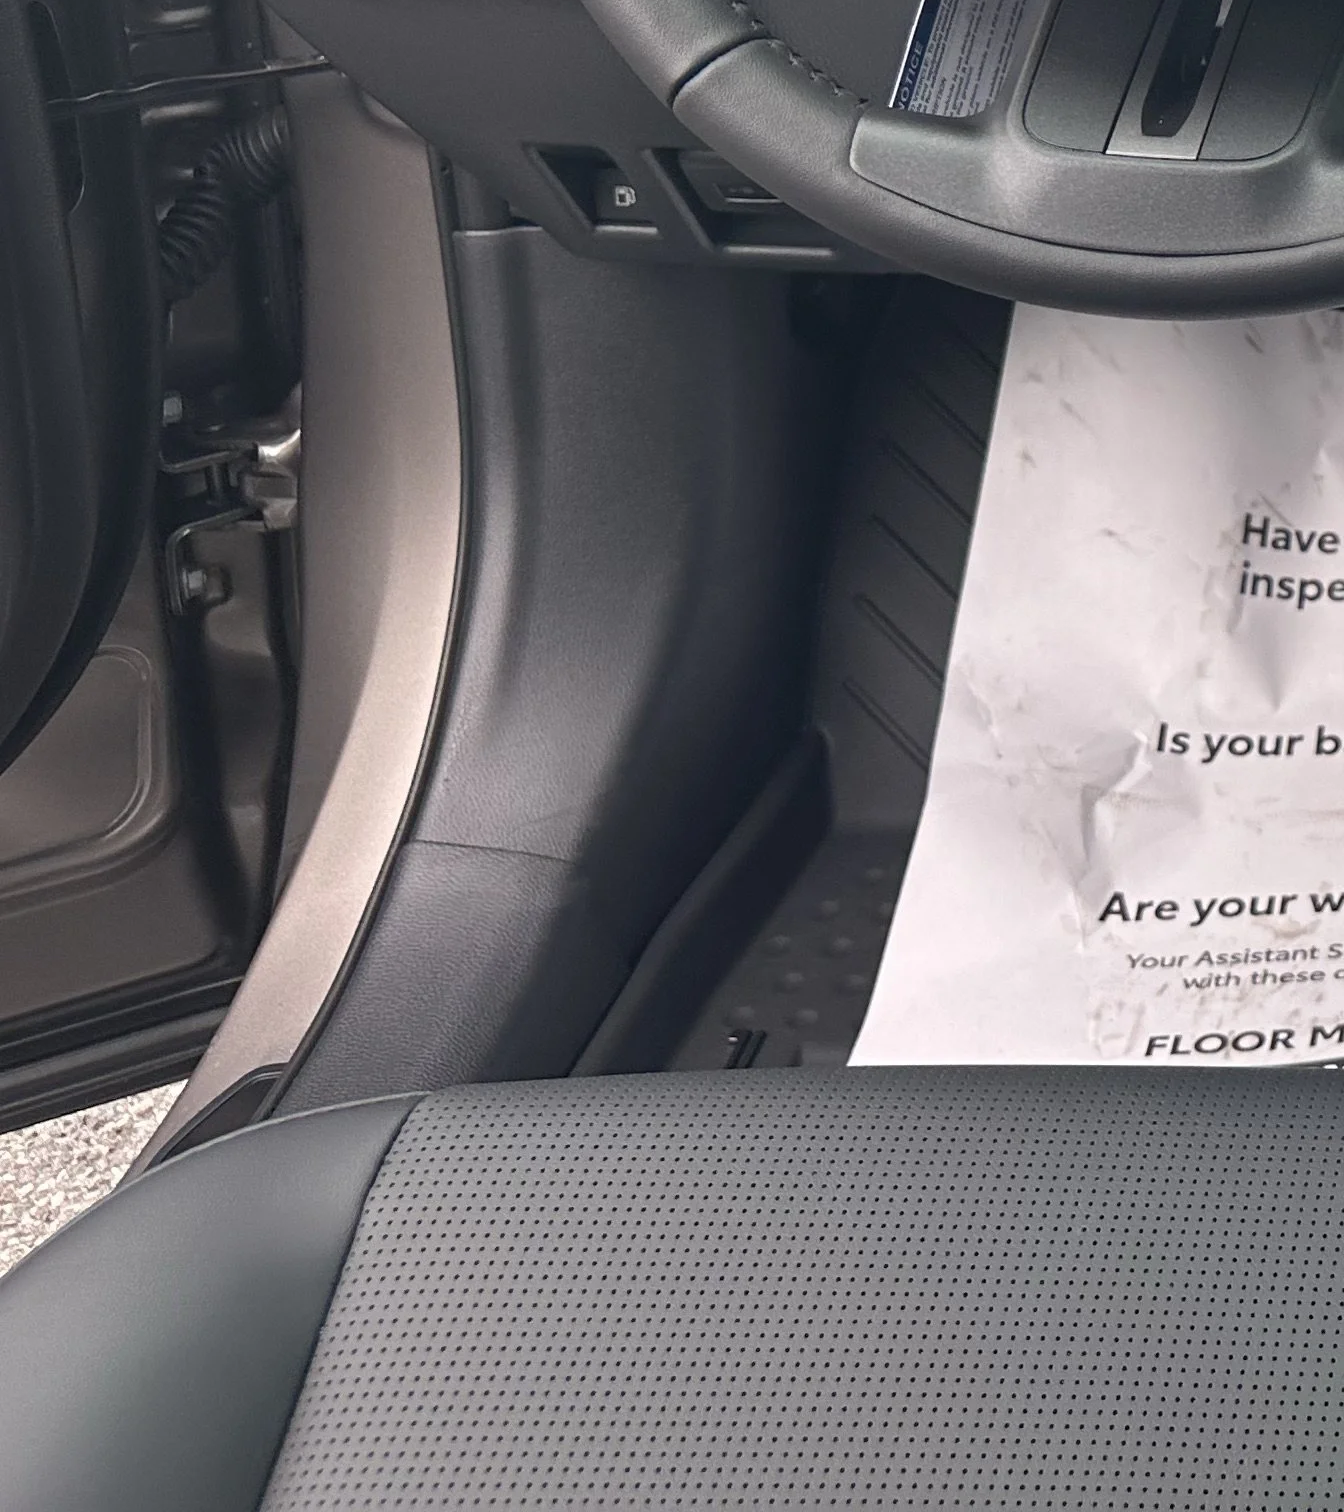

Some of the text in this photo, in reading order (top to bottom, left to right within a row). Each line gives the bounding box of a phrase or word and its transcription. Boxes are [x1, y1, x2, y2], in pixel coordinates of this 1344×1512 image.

[1242, 512, 1340, 554] Have
[1155, 722, 1190, 755] Is
[1203, 730, 1304, 763] your
[1099, 890, 1179, 923] Are
[1192, 889, 1298, 927] your
[1126, 953, 1188, 970] Your
[1194, 944, 1319, 967] Assistant
[1182, 971, 1241, 991] with
[1250, 966, 1326, 986] these
[1144, 1028, 1296, 1057] FLOOR
